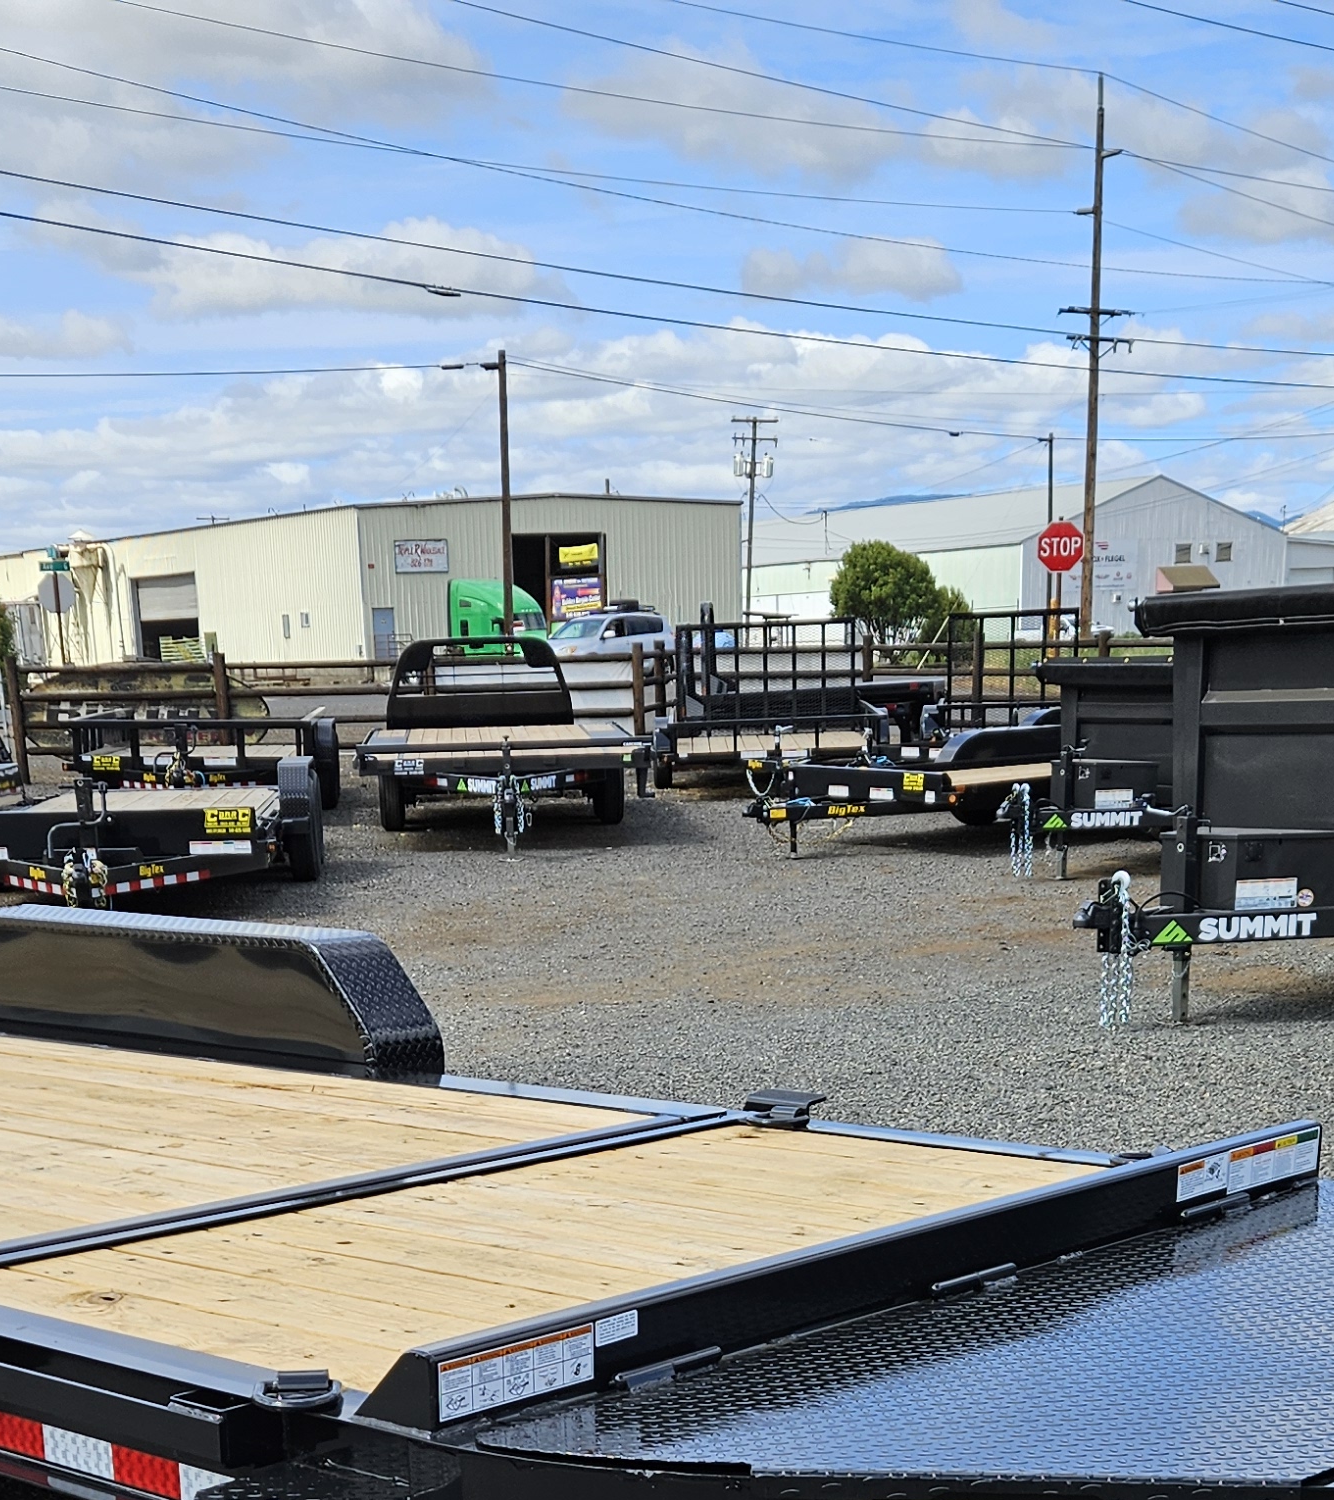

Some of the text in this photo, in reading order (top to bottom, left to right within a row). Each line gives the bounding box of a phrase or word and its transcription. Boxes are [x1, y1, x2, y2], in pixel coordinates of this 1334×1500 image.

[1040, 537, 1082, 557] STOP
[467, 778, 497, 794] SUMMIT
[828, 804, 866, 817] BigTex
[1070, 811, 1143, 828] SUMMIT
[139, 864, 165, 877] BigTex
[1198, 912, 1317, 941] SUMMIT
